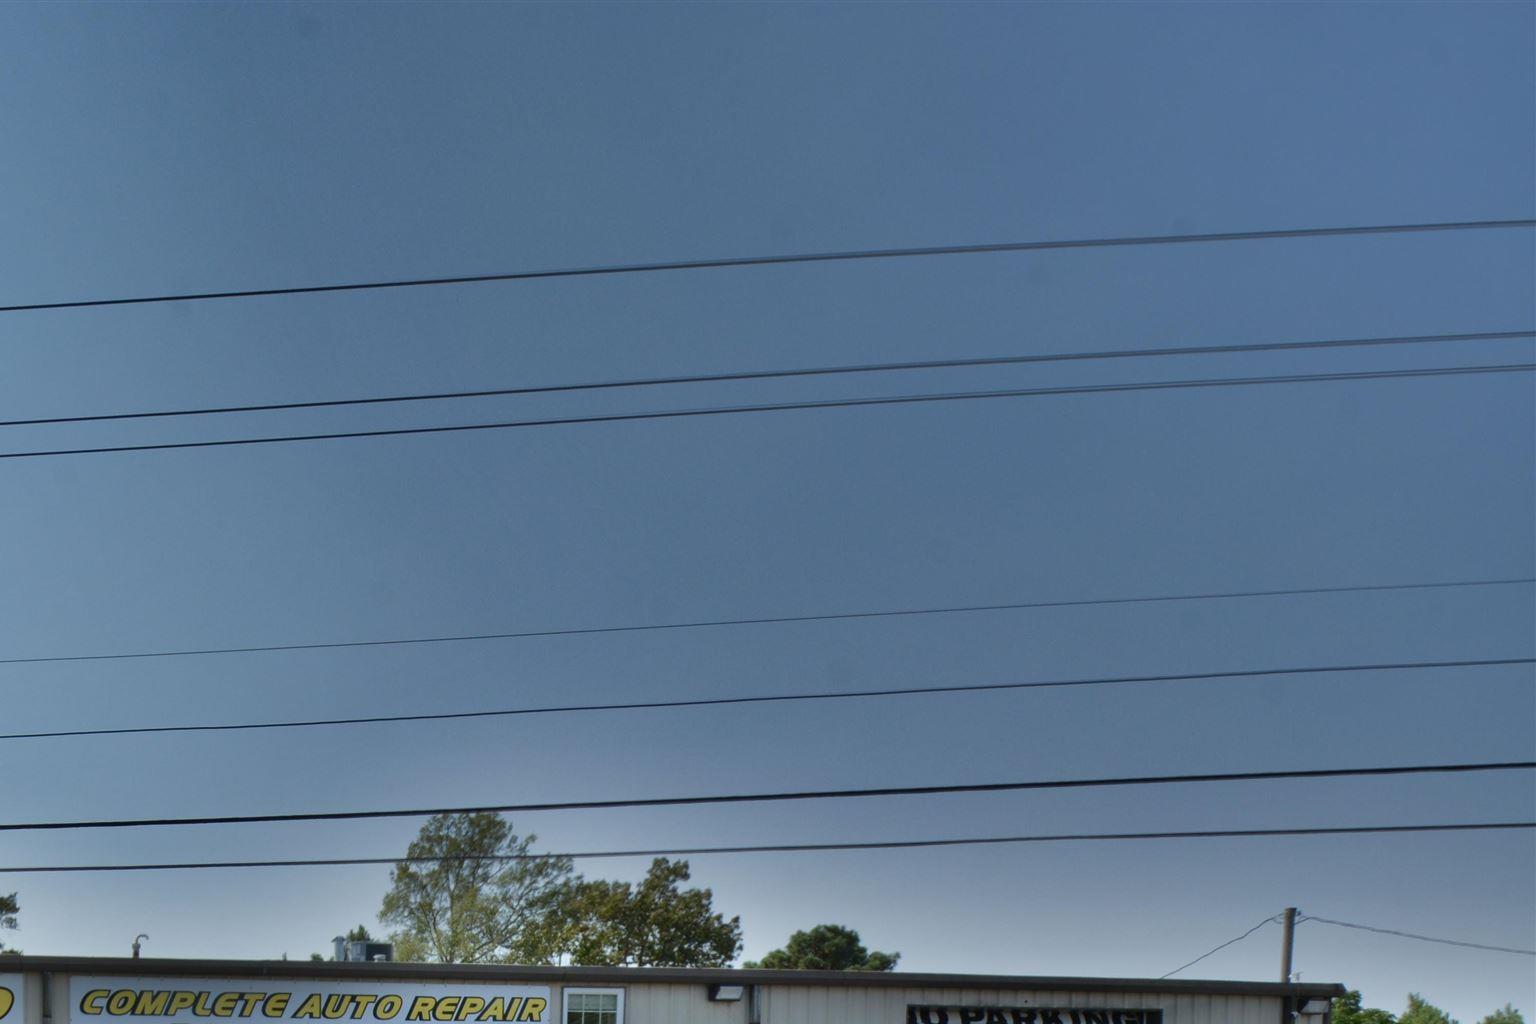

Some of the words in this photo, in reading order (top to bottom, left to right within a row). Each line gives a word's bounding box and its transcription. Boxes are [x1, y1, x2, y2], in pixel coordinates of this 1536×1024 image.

[79, 989, 291, 1018] COMPLETE
[291, 993, 404, 1020] AUTO
[405, 995, 548, 1022] REPAIR
